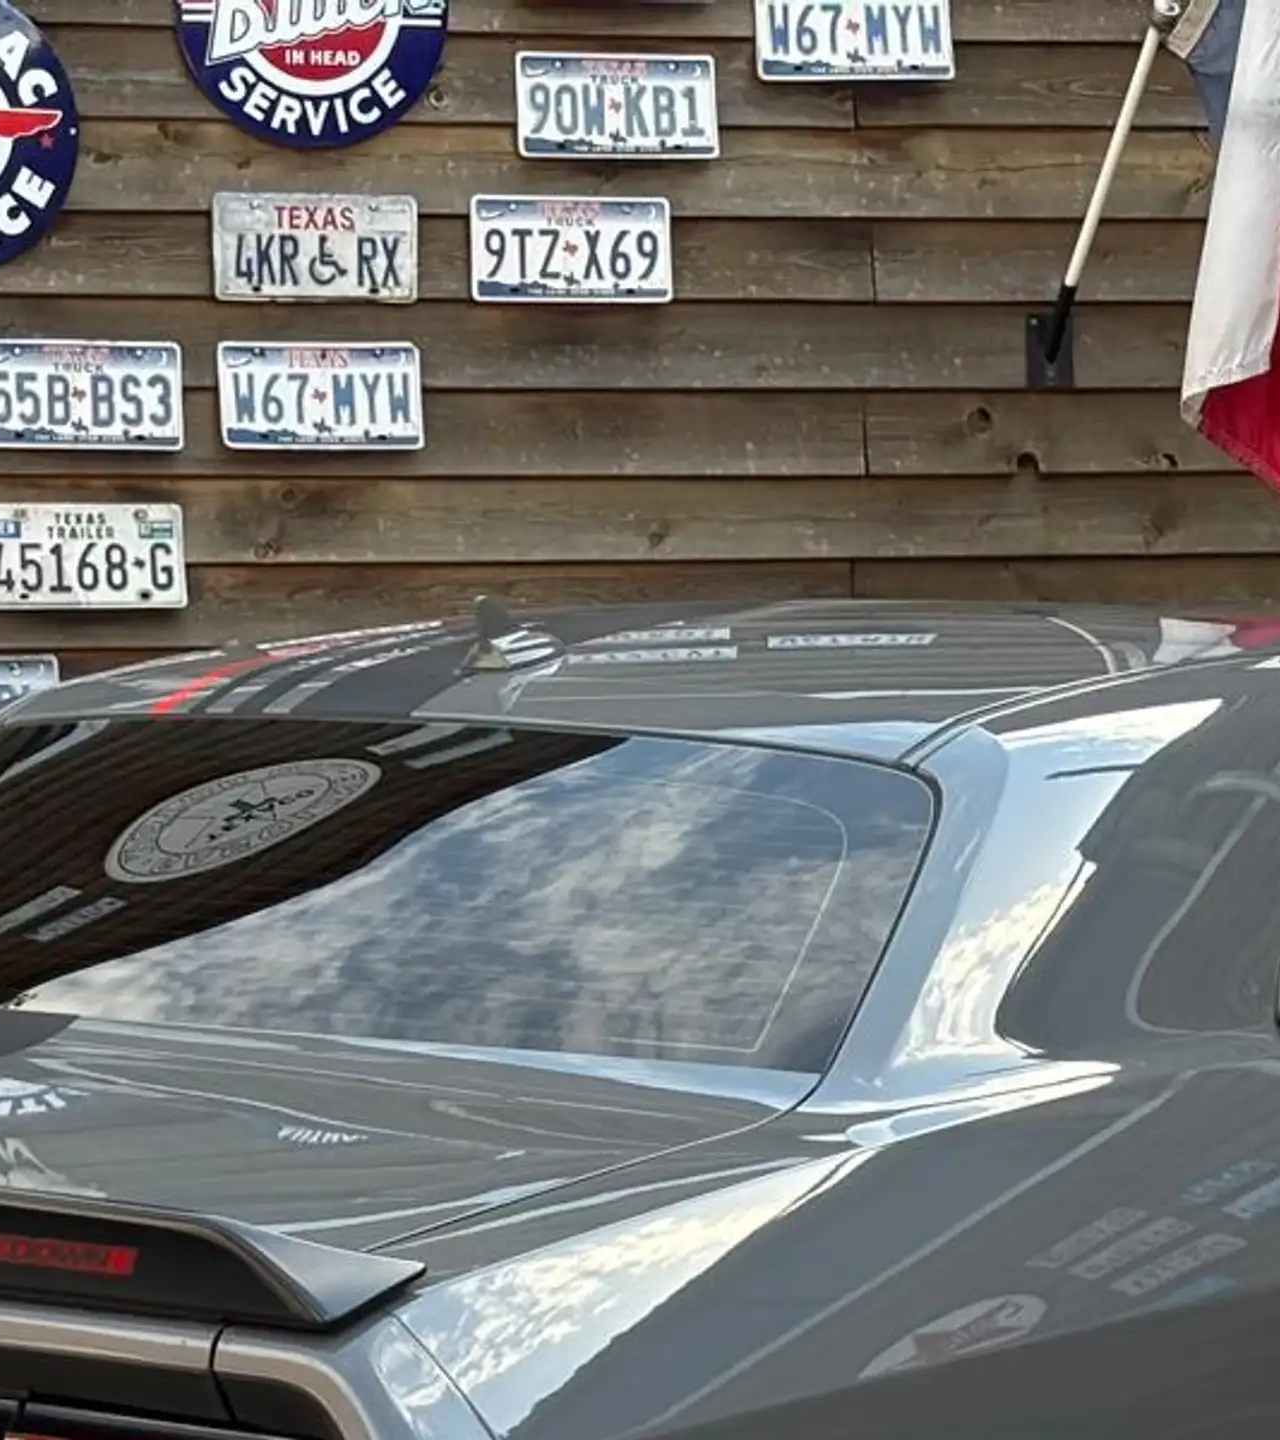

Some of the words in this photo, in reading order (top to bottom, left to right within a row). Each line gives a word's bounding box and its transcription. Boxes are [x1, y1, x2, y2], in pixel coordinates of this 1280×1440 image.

[768, 4, 843, 55] W67
[864, 4, 942, 55] MYW
[284, 49, 306, 65] IN
[310, 50, 361, 67] HEAD
[218, 67, 407, 135] SERVICE
[529, 82, 606, 136] 90W
[623, 84, 706, 137] KB1
[275, 206, 355, 231] TEXAS
[235, 233, 301, 286] 4KR
[357, 237, 402, 287] RX
[484, 228, 562, 280] 9TZ
[583, 229, 659, 280] X69
[90, 373, 174, 427] BS3
[232, 372, 311, 425] W67
[332, 372, 411, 426] MYW
[47, 526, 117, 539] TRAILER
[54, 513, 108, 526] TEXAS
[150, 542, 175, 592] G
